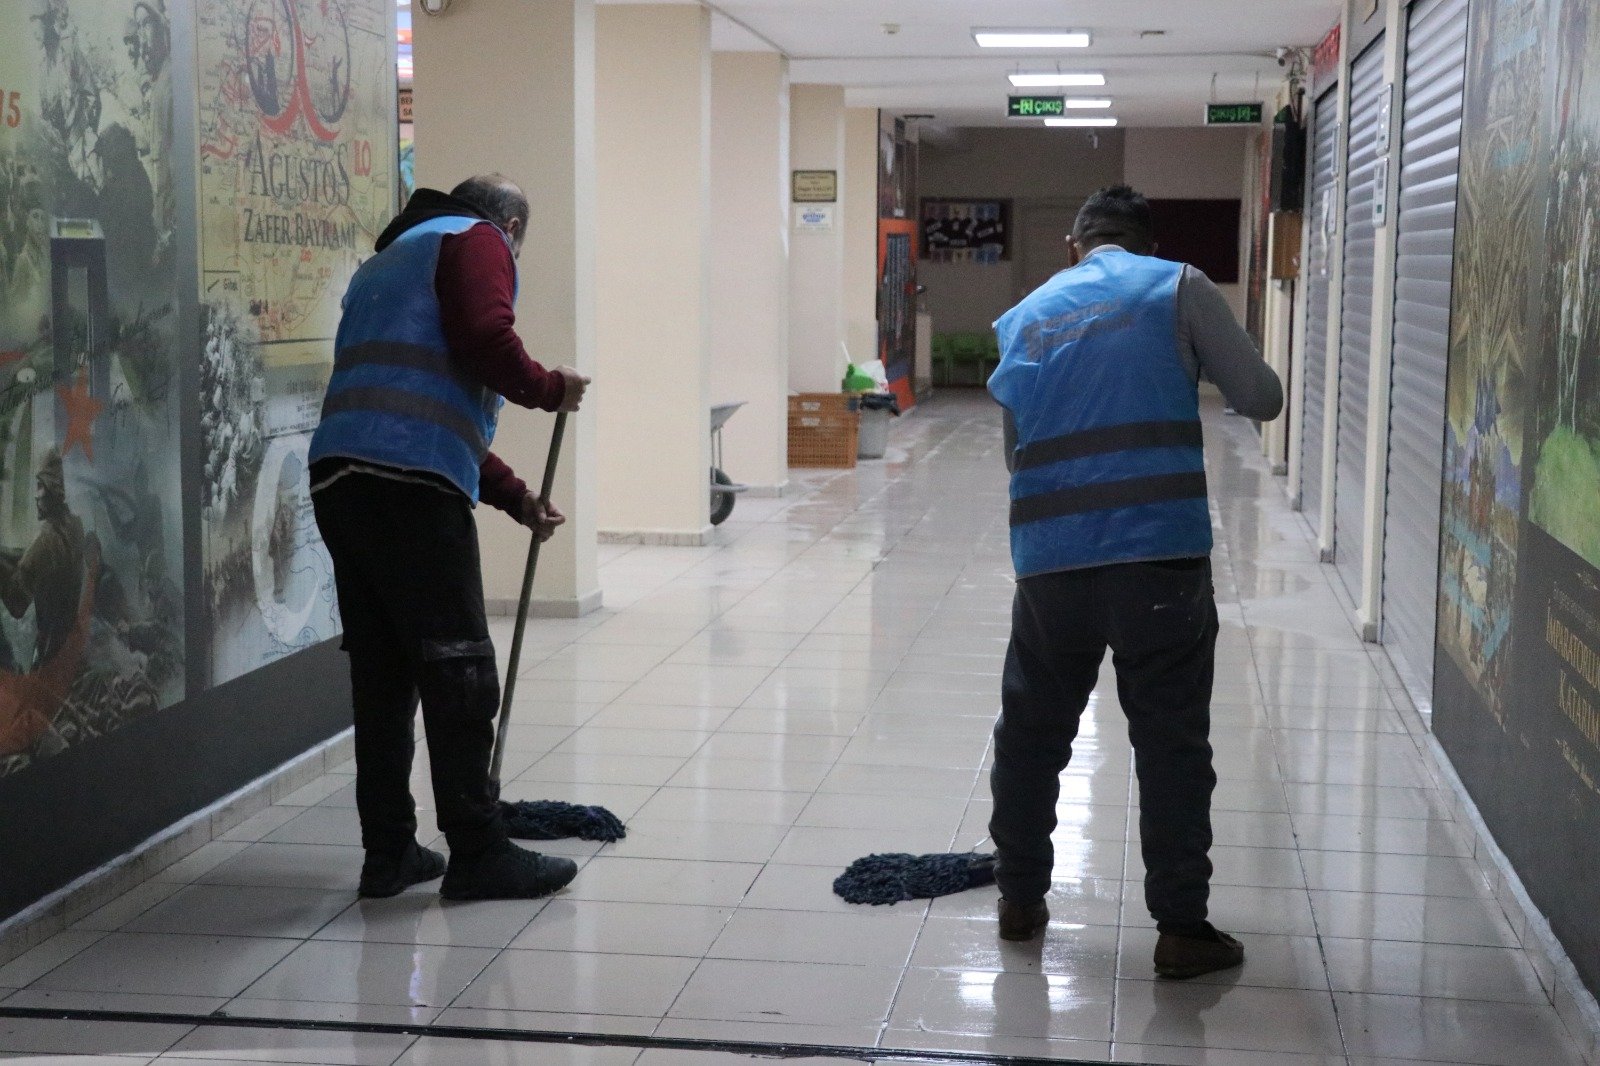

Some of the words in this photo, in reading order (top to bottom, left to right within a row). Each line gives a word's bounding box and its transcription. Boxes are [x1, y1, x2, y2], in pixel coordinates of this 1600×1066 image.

[1034, 100, 1063, 115] ÇIKIŞ
[244, 208, 292, 244] ZAFER
[295, 213, 356, 250] BAYRAMI
